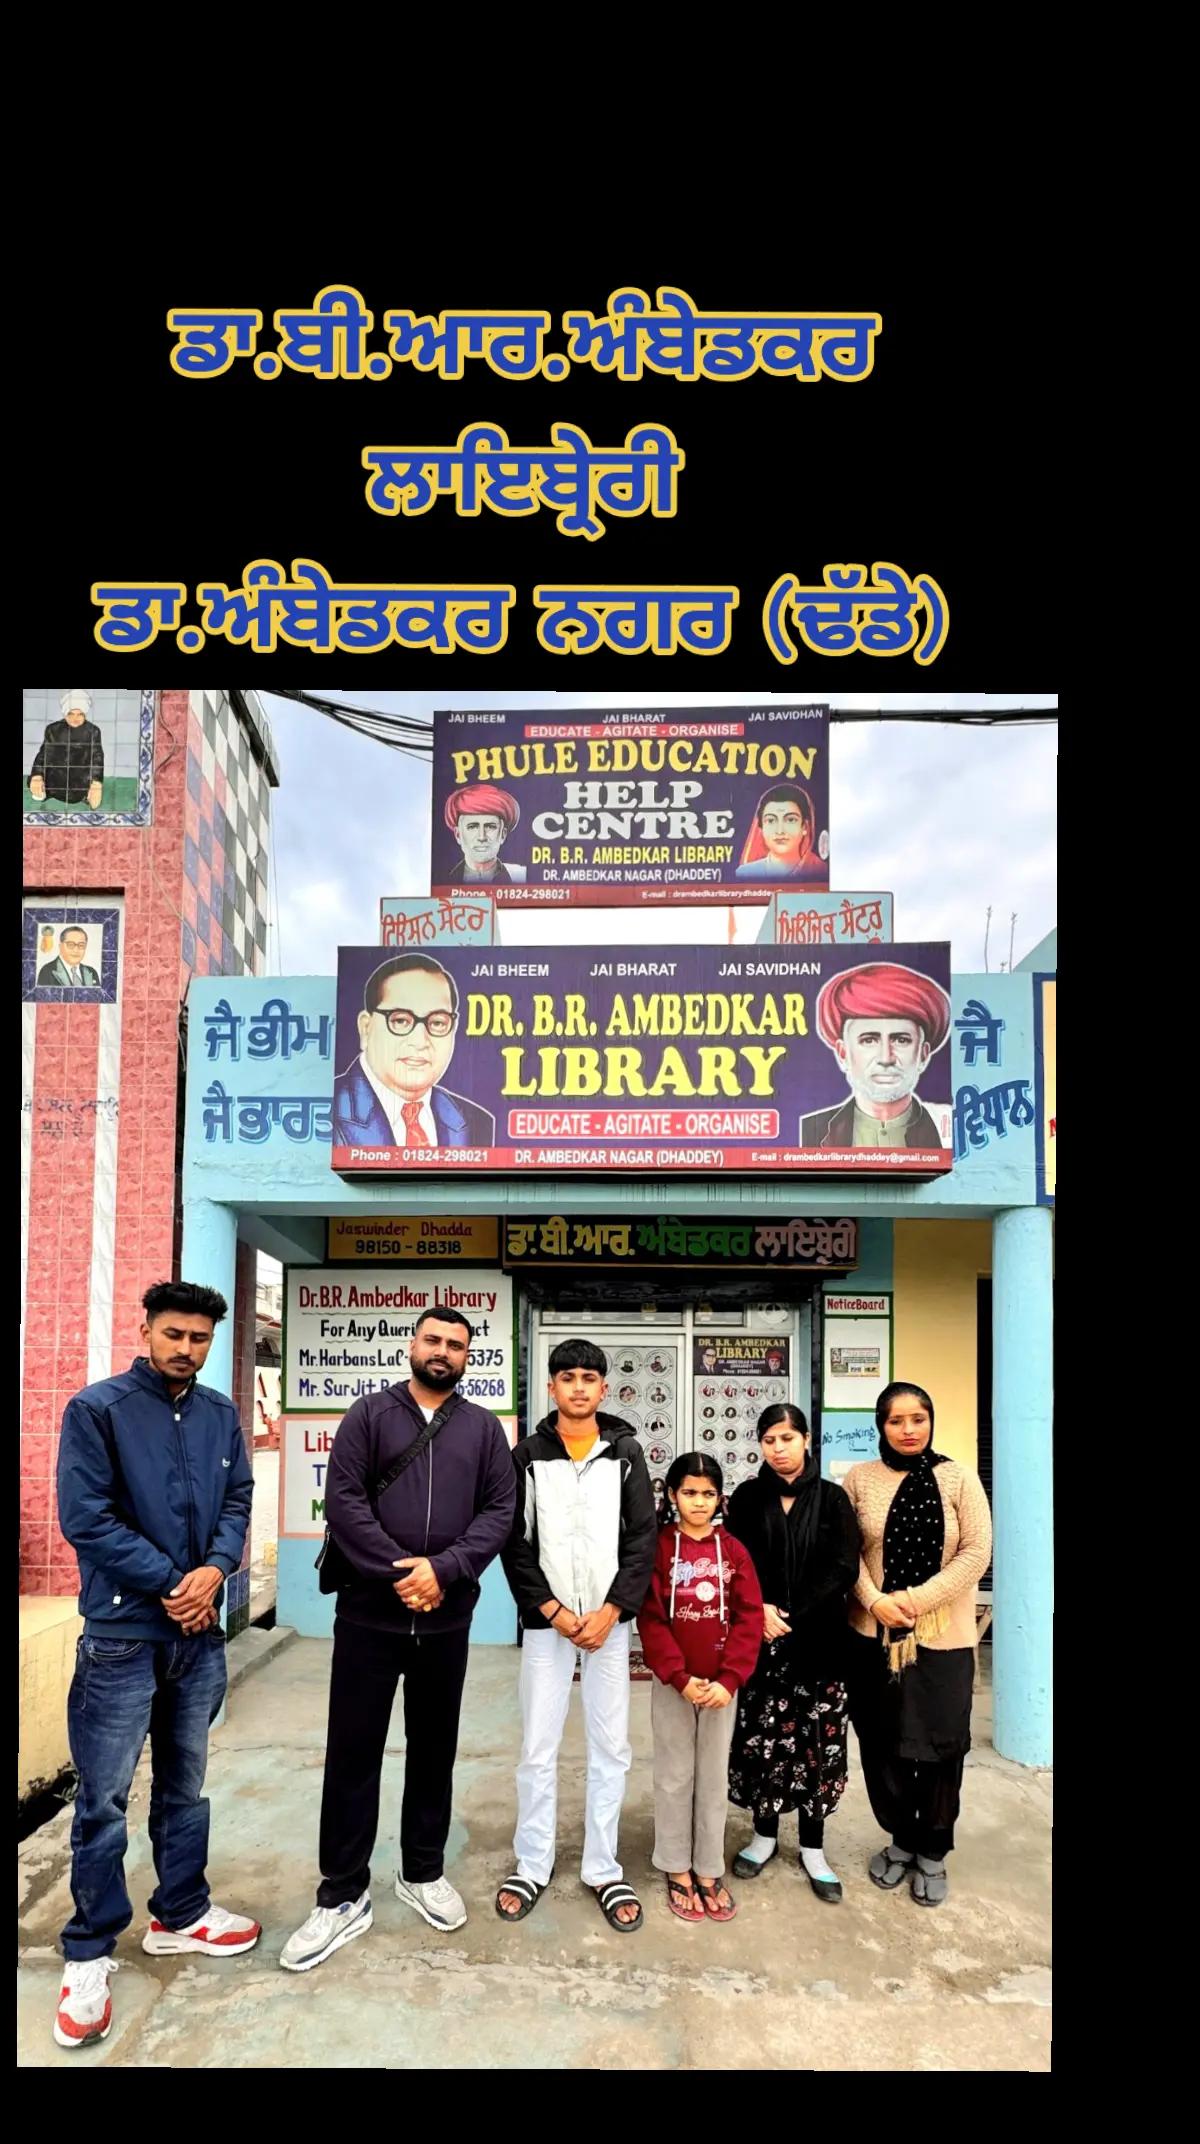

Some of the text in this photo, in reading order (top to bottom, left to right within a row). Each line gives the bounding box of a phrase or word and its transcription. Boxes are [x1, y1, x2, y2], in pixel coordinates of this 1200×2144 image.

[448, 714, 506, 724] JAI BHEEM
[602, 713, 666, 724] JAI BHARAT
[748, 708, 823, 723] JAI SAVIDHAN
[530, 726, 591, 737] EDUCATE
[603, 725, 657, 737] AGITATE
[669, 725, 738, 736] ORGANISE
[452, 739, 817, 784] PHULE EDUCATION
[562, 780, 703, 810] HELP
[531, 810, 735, 841] CENTRE
[532, 846, 734, 864] DR. B.R. AMBEDKAR LIBRARY
[543, 868, 722, 883] DR. AMBEDKAR NAGAR (DHADDEY)
[496, 889, 571, 900] 01824-298021
[470, 963, 550, 977] JAI BHEEM
[589, 963, 678, 977] JAI BHARAT
[718, 962, 821, 977] JAI SAVIDHAN
[465, 993, 808, 1037] DR. B.R. AMBEDKAR
[501, 1046, 787, 1097] LIBRARY
[515, 1112, 591, 1135] EDUCATE
[603, 1113, 672, 1135] AGITATE
[685, 1112, 771, 1135] ORGANISE
[350, 1149, 391, 1162] Phone
[402, 1149, 488, 1162] 01824-298021
[514, 1148, 724, 1168] DR. AMBEDKAR NAGAR (DHADDEY)
[751, 1152, 777, 1162] E-mail
[336, 1221, 473, 1237] Jaswinder Dhadda
[355, 1240, 401, 1255] 98150
[416, 1240, 462, 1255] 88318
[348, 1285, 430, 1308] Ambedkar
[434, 1285, 497, 1312] Library
[320, 1319, 416, 1342] For Any Queri
[716, 1347, 767, 1359] LIBRARY
[299, 1379, 320, 1397] Mr.
